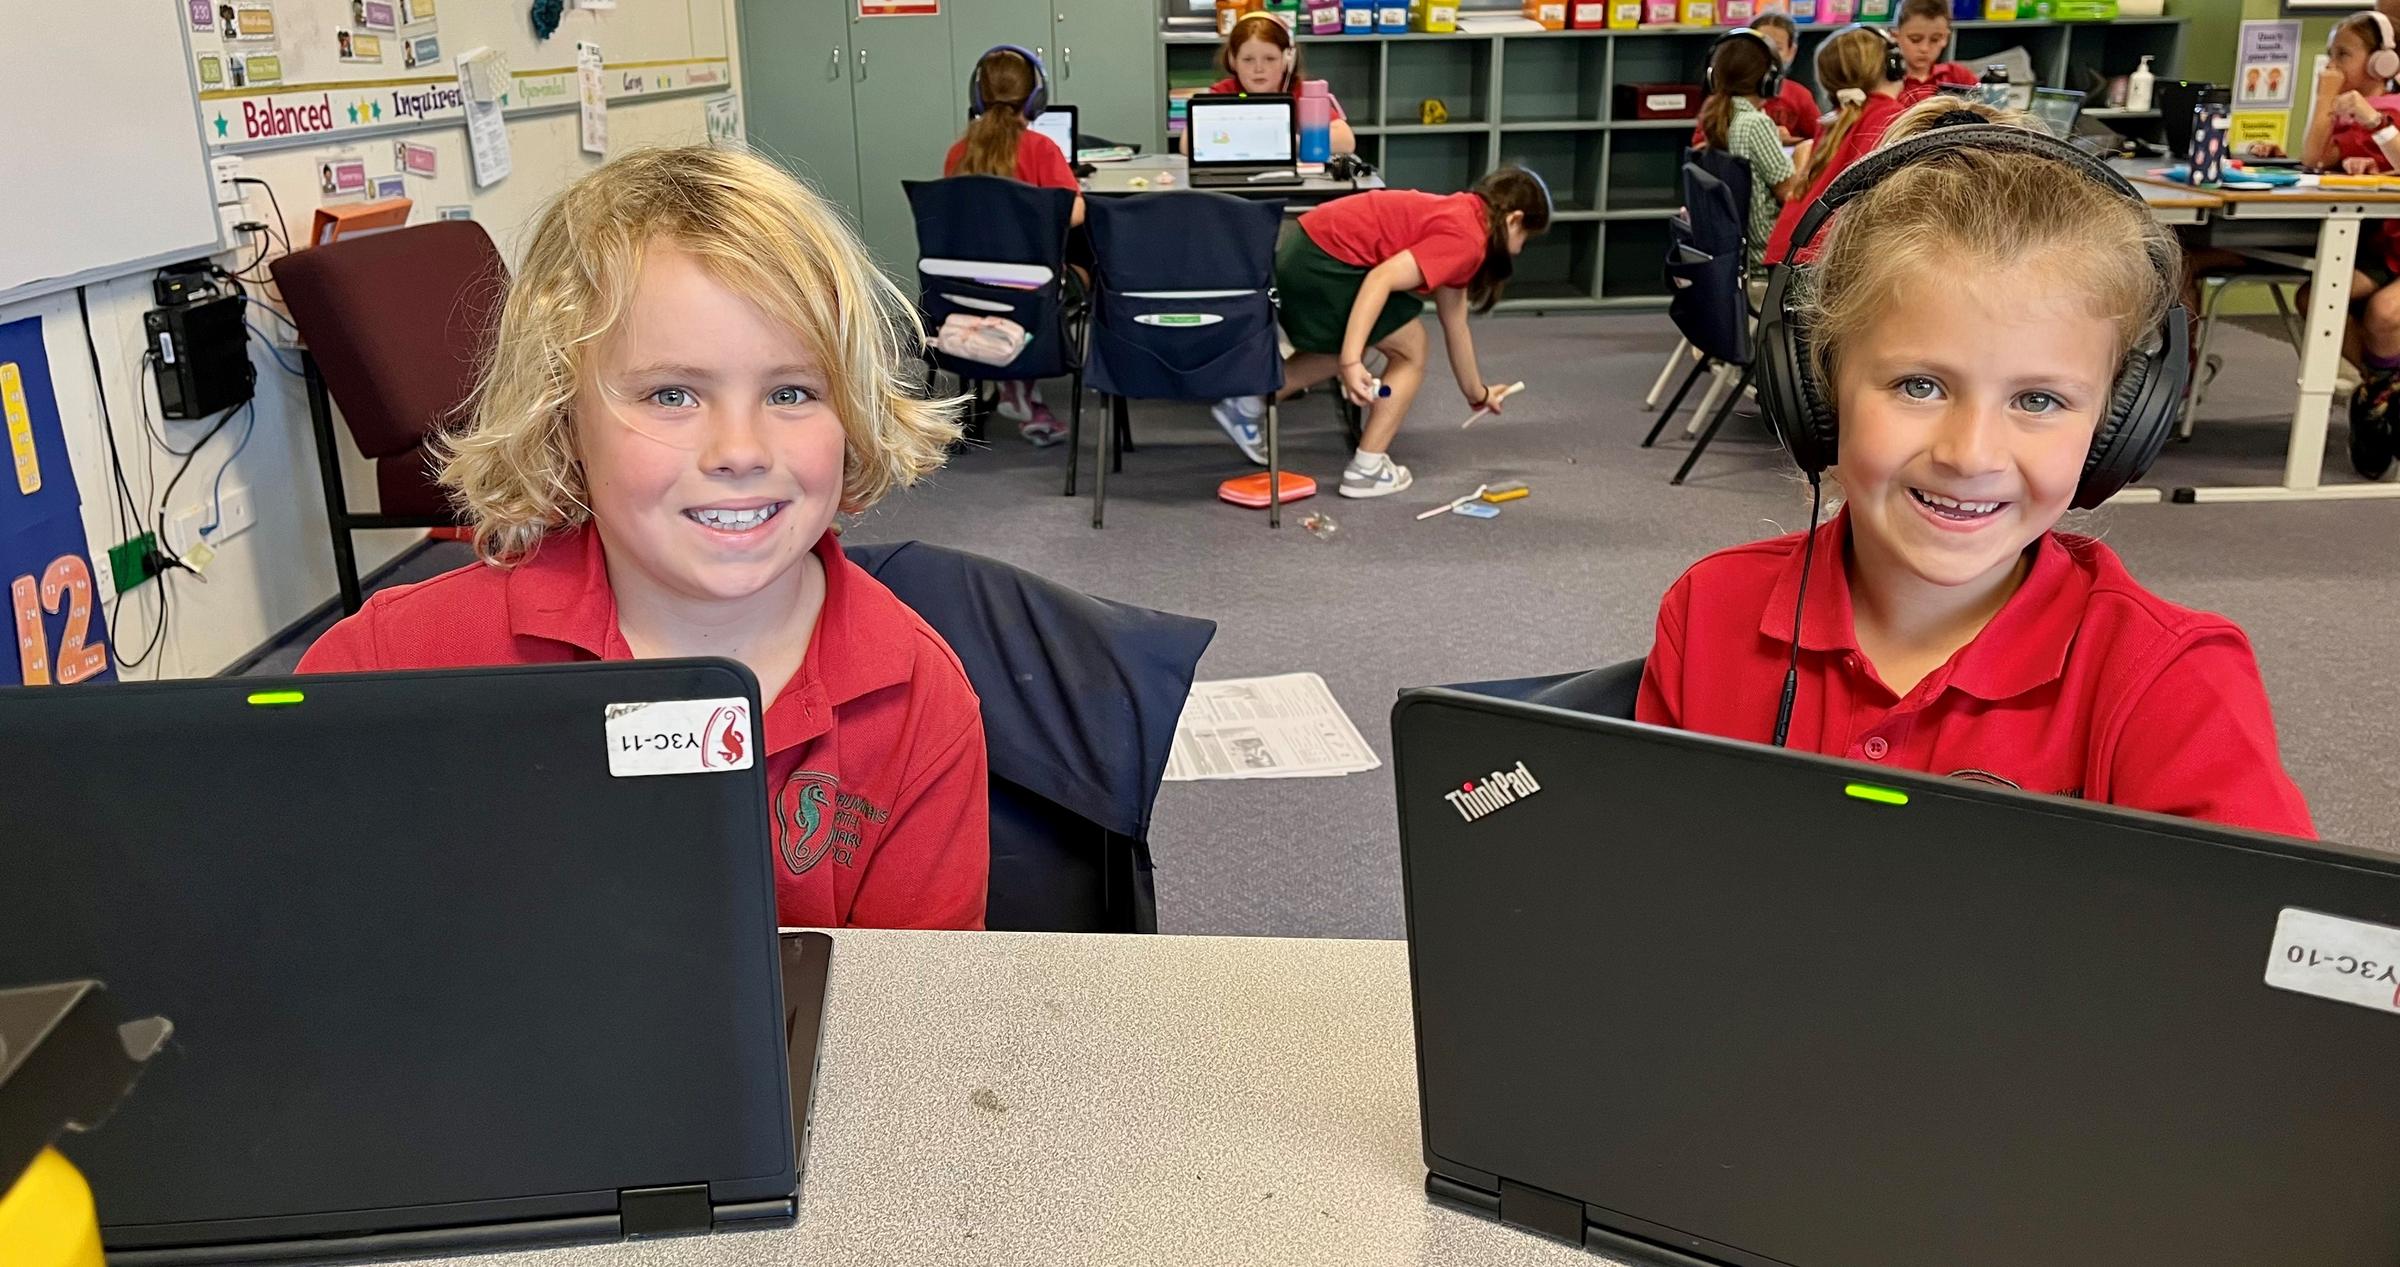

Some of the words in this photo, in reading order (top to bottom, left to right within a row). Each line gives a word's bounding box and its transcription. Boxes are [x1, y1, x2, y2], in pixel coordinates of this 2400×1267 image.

[243, 94, 333, 138] Balanced
[622, 733, 700, 752] Y3C-11
[1444, 760, 1541, 822] ThinkPad
[2287, 945, 2398, 984] Y3C-10
